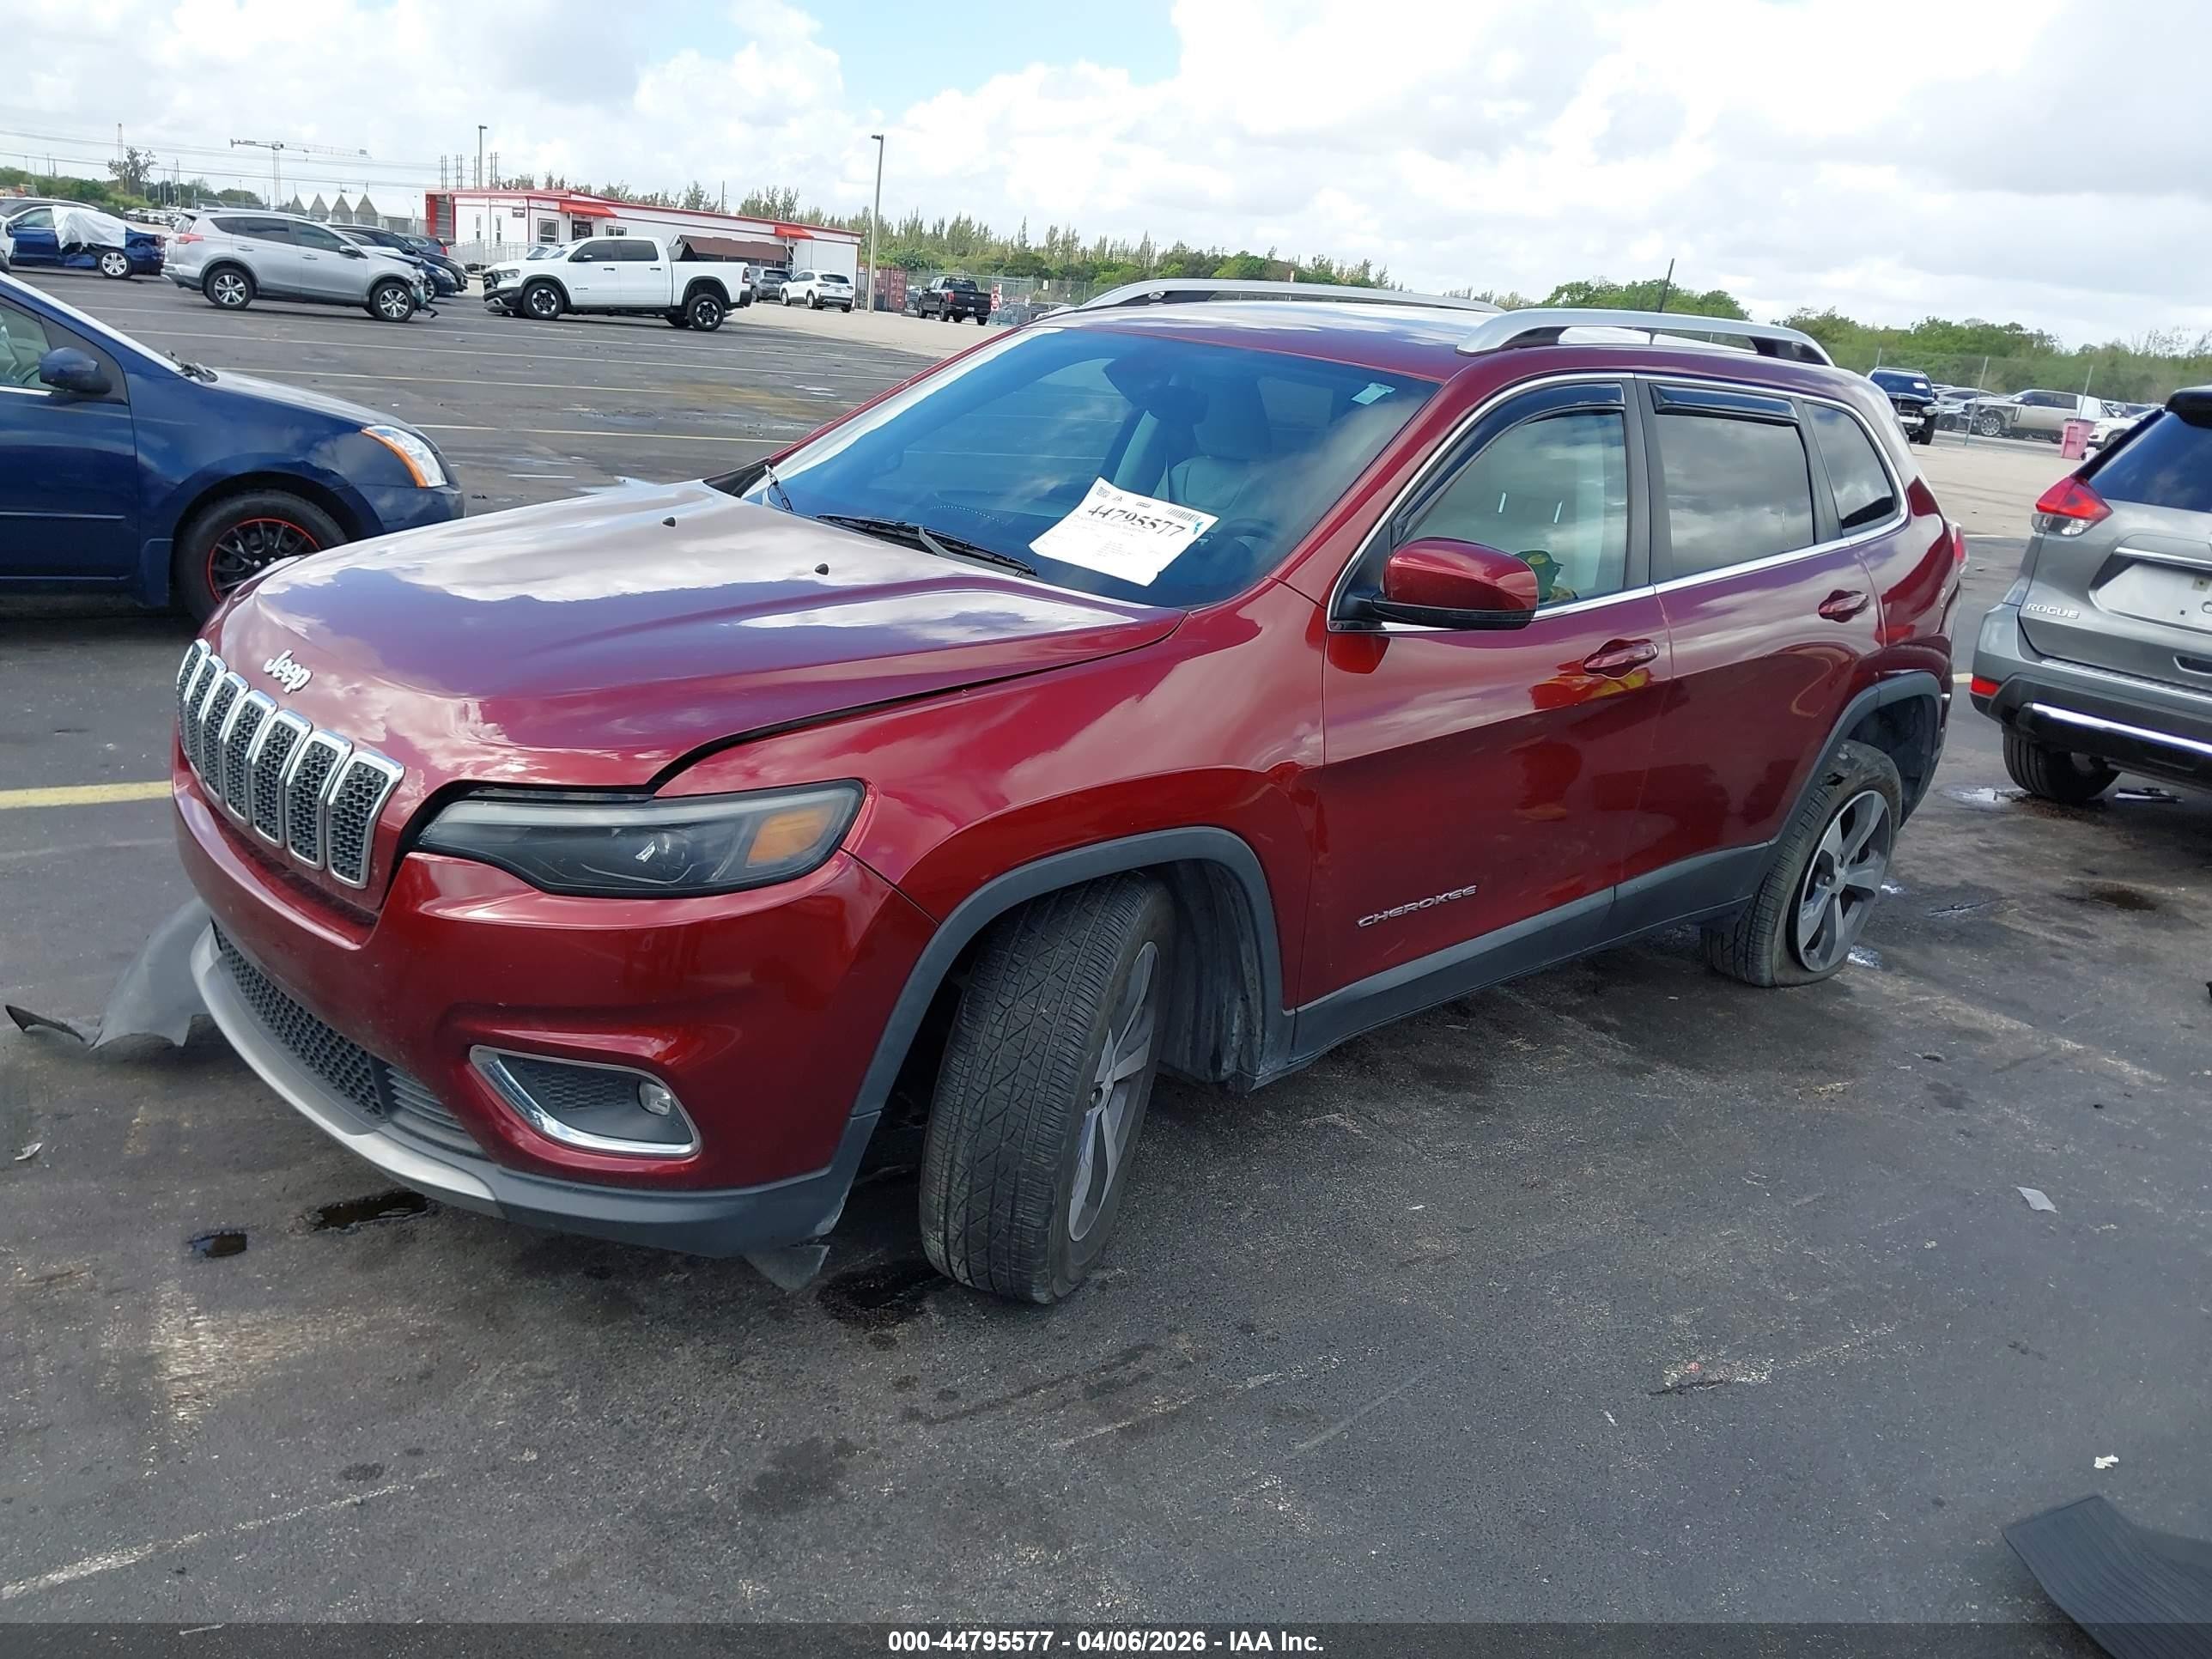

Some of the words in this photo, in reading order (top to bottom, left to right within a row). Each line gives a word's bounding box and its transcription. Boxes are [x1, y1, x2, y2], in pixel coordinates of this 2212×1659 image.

[1088, 505, 1187, 537] 44795577
[2027, 603, 2081, 619] ROGUE
[263, 649, 313, 694] Jeep
[1358, 884, 1477, 927] CHEROKEE
